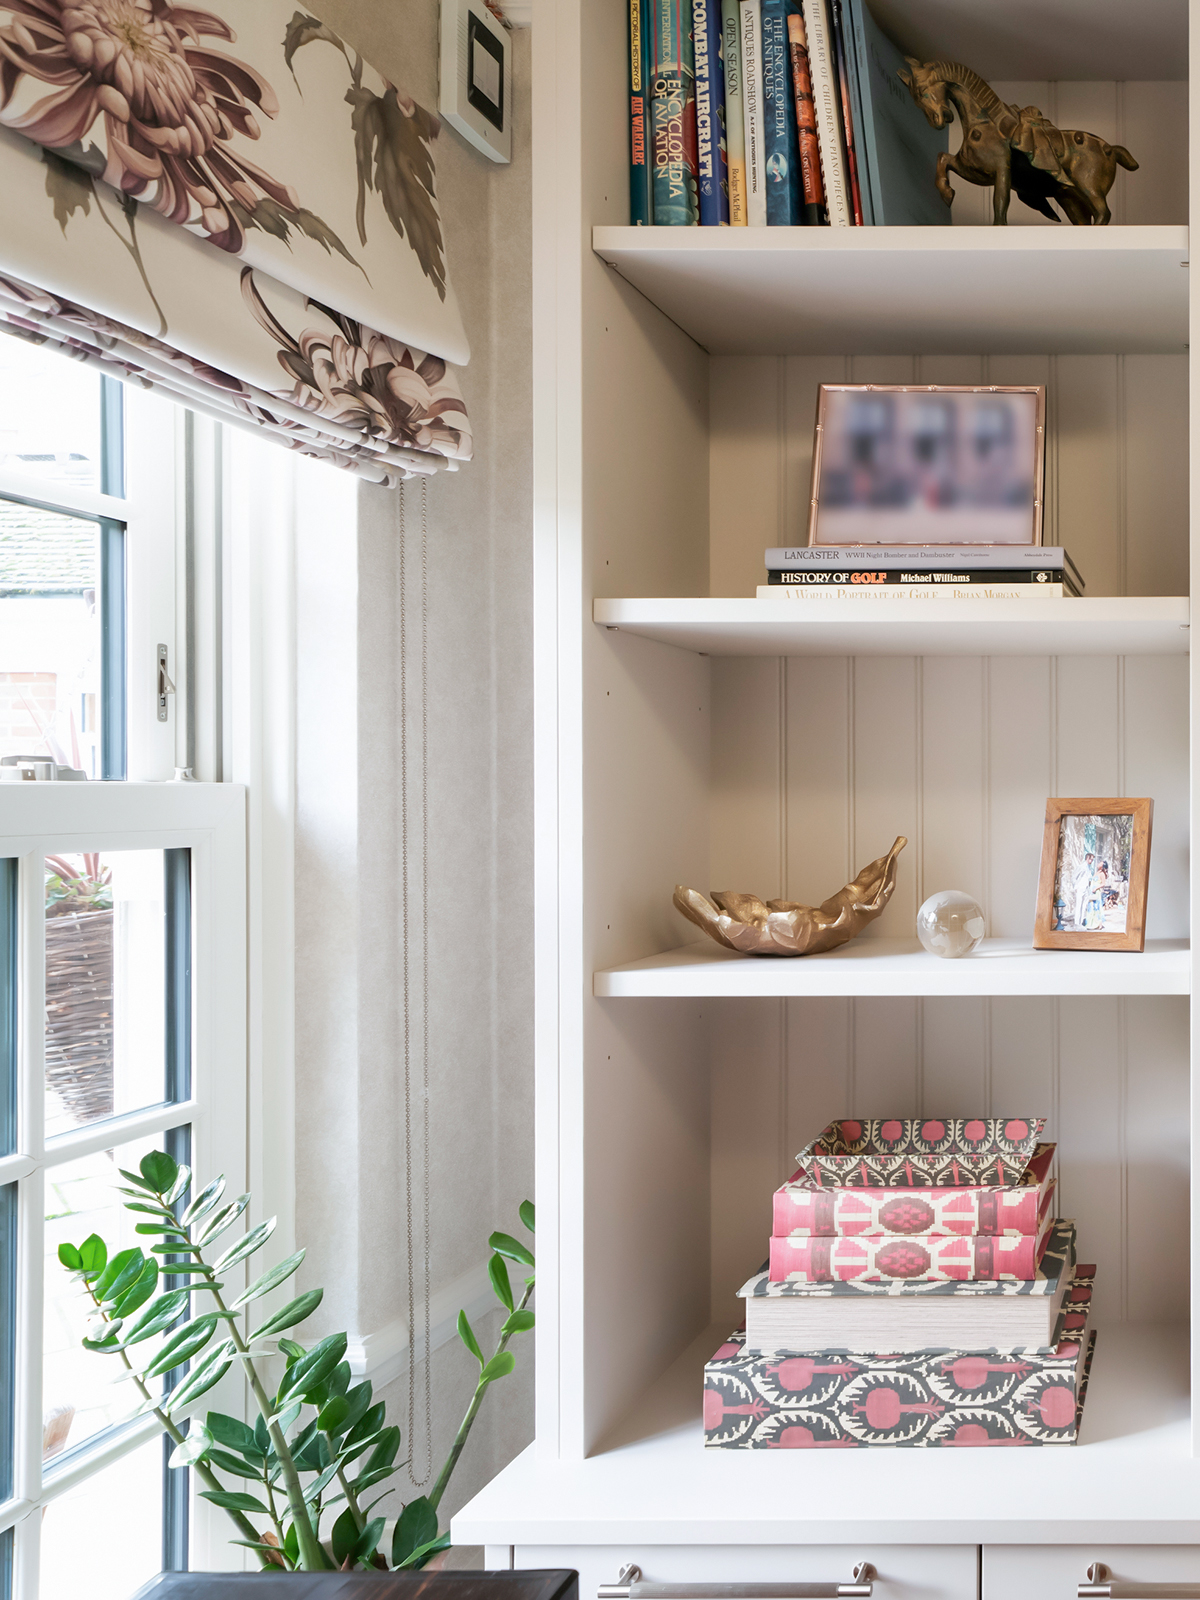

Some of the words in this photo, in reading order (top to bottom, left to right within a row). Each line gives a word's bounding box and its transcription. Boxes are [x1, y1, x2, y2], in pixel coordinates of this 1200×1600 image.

[662, 0, 672, 78] INTERNATIONL
[692, 0, 709, 78] COMBAT
[726, 18, 736, 48] OPEN
[744, 10, 755, 57] ANTIQUES
[764, 18, 772, 33] OF
[774, 17, 782, 42] THE
[815, 24, 826, 64] LIBRARY
[727, 53, 738, 96] SEASON
[764, 36, 774, 100] ANTIQUES
[820, 66, 828, 80] OF
[633, 78, 640, 89] OF
[654, 79, 667, 101] OF
[746, 59, 756, 114] ROADSHOW
[774, 46, 786, 138] ENCYCLOPEDIA
[632, 96, 644, 114] AIR
[822, 84, 836, 143] CHILDREN'S
[632, 115, 644, 166] WARFARE
[656, 103, 668, 178] AVIATION
[667, 80, 683, 198] ENCYCLOPEDIA
[696, 81, 712, 178] AIRCRAFT
[750, 126, 755, 134] OF
[803, 158, 809, 168] ON
[830, 146, 840, 176] PIANO
[732, 168, 740, 192] Rodger
[733, 193, 741, 222] McPhail
[834, 180, 844, 212] PIECES
[784, 551, 840, 560] LANCASTER
[781, 573, 832, 583] HISTORY
[833, 573, 850, 583] OF
[850, 572, 887, 584] GOLF
[900, 573, 932, 582] Michael
[932, 574, 970, 582] Williams
[785, 590, 791, 599] A
